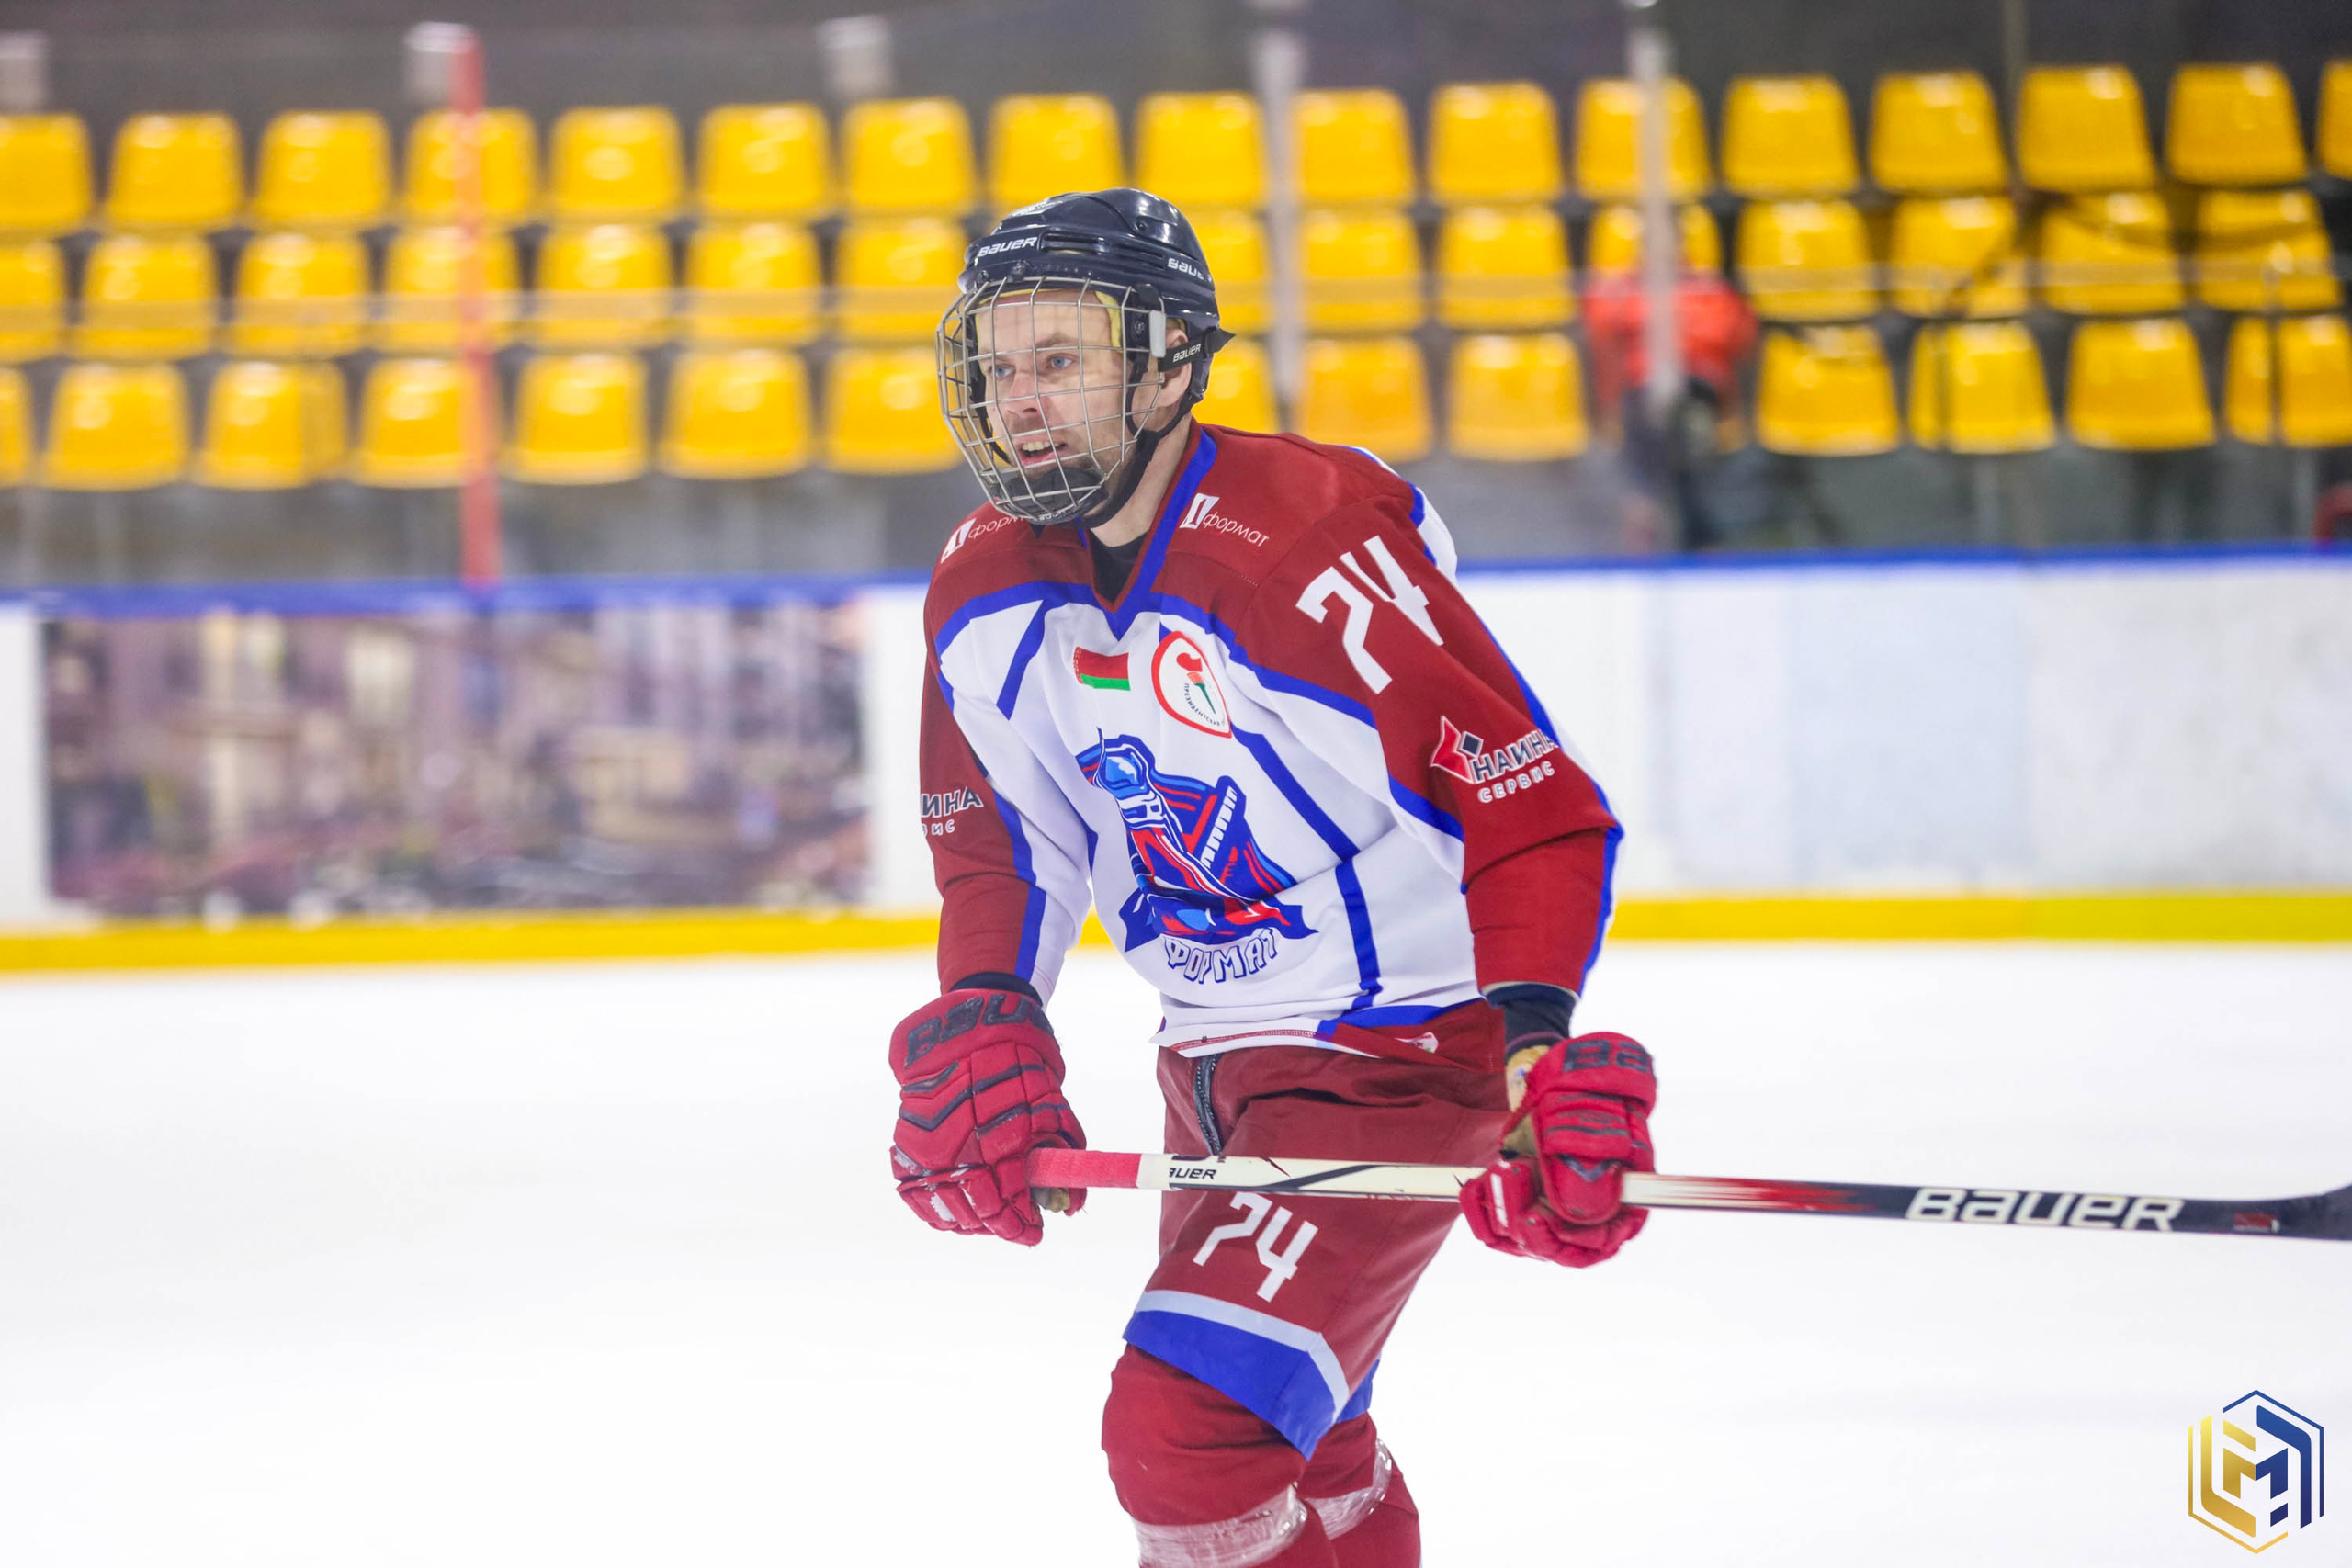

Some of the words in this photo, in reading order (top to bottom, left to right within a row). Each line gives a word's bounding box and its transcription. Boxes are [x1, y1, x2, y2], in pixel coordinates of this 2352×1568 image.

[978, 236, 1038, 258] BAUER
[1172, 343, 1202, 363] BAUER
[1203, 511, 1270, 547] формат
[1295, 535, 1444, 694] 74
[921, 786, 985, 818] ИНА
[1477, 761, 1555, 803] СЕРВИС
[1164, 928, 1278, 985] ФОРМАТ
[1905, 1187, 2185, 1231] BAUER
[1193, 1191, 1319, 1303] 74
